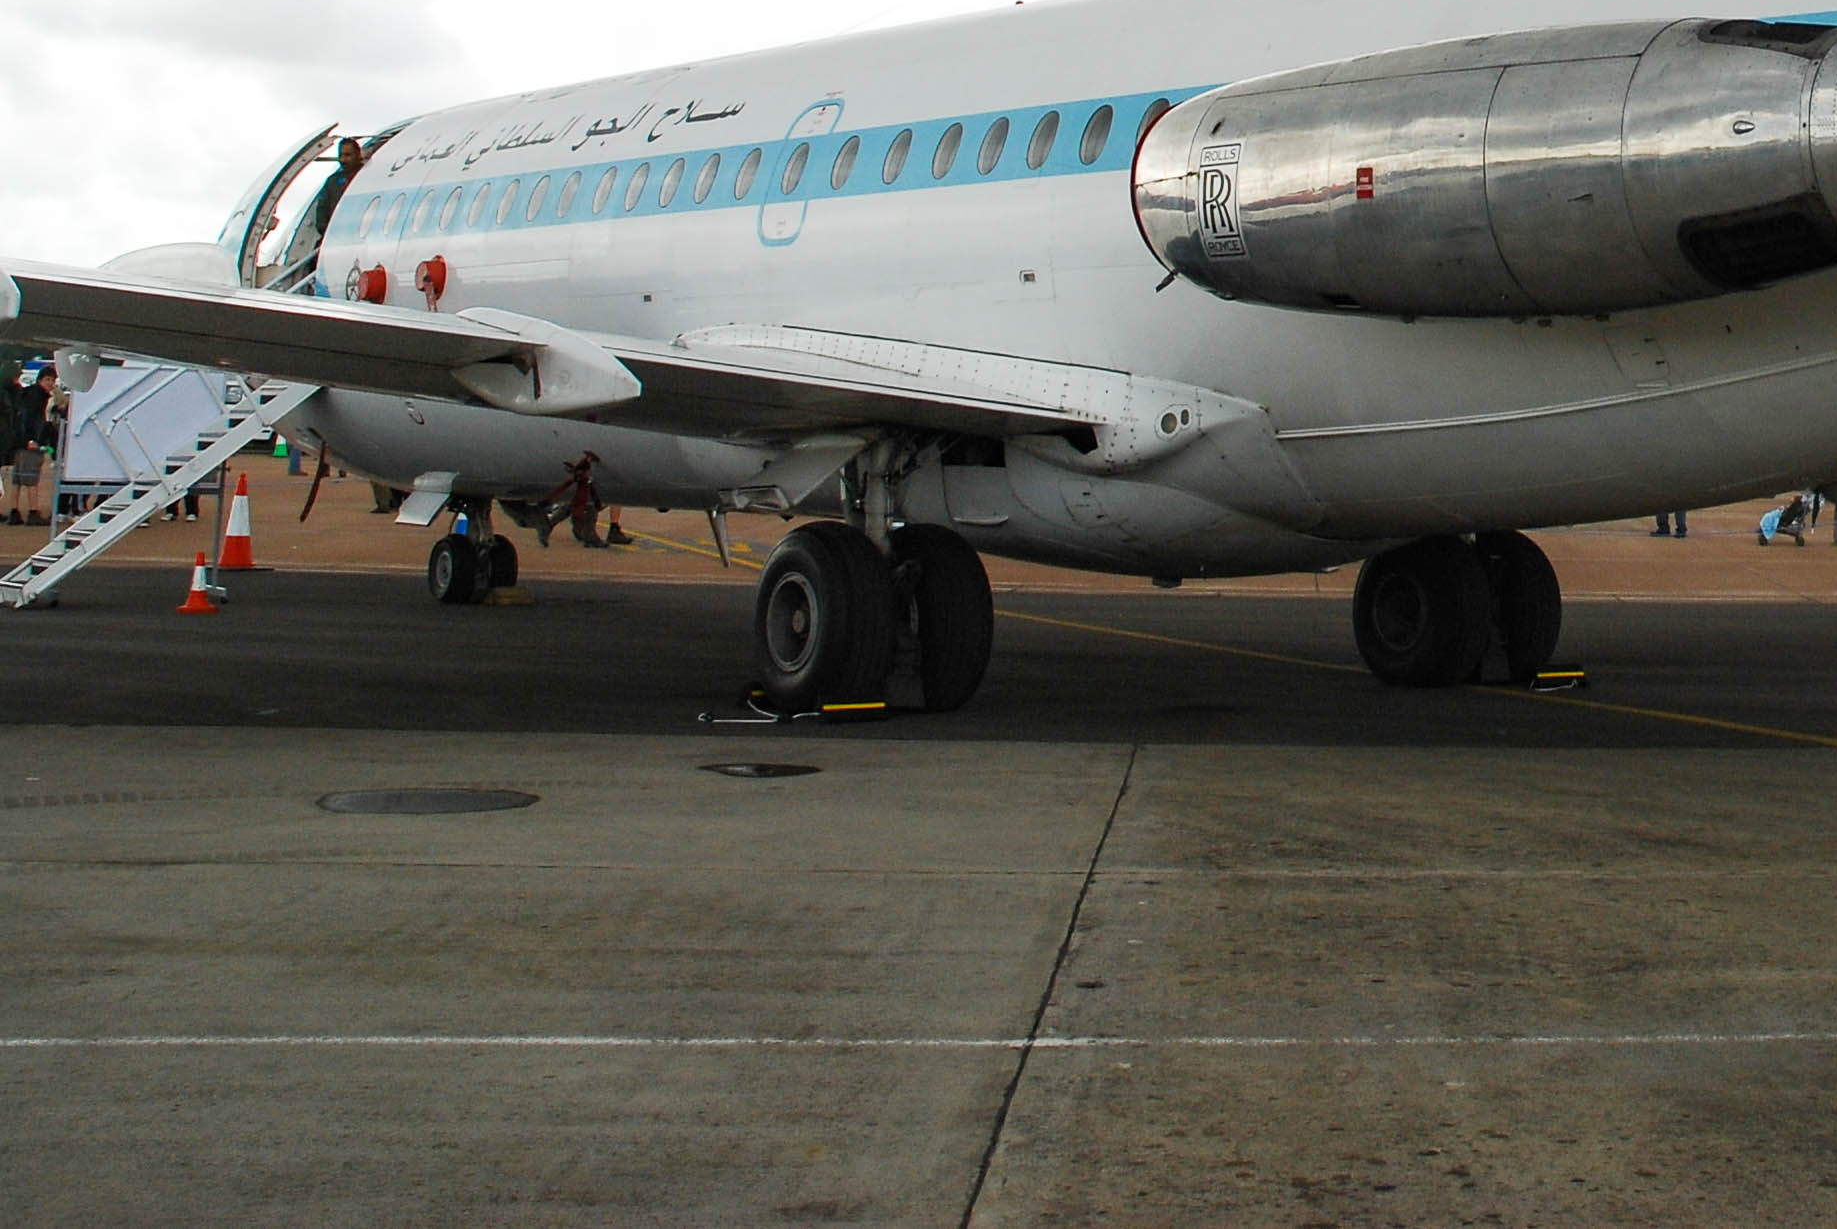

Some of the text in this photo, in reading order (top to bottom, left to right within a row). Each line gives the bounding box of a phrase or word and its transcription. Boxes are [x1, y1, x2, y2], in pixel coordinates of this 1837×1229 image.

[571, 101, 659, 151] الجو
[648, 99, 745, 143] سلاح
[1204, 149, 1237, 162] ROLLS
[1208, 240, 1240, 251] ROYCE
